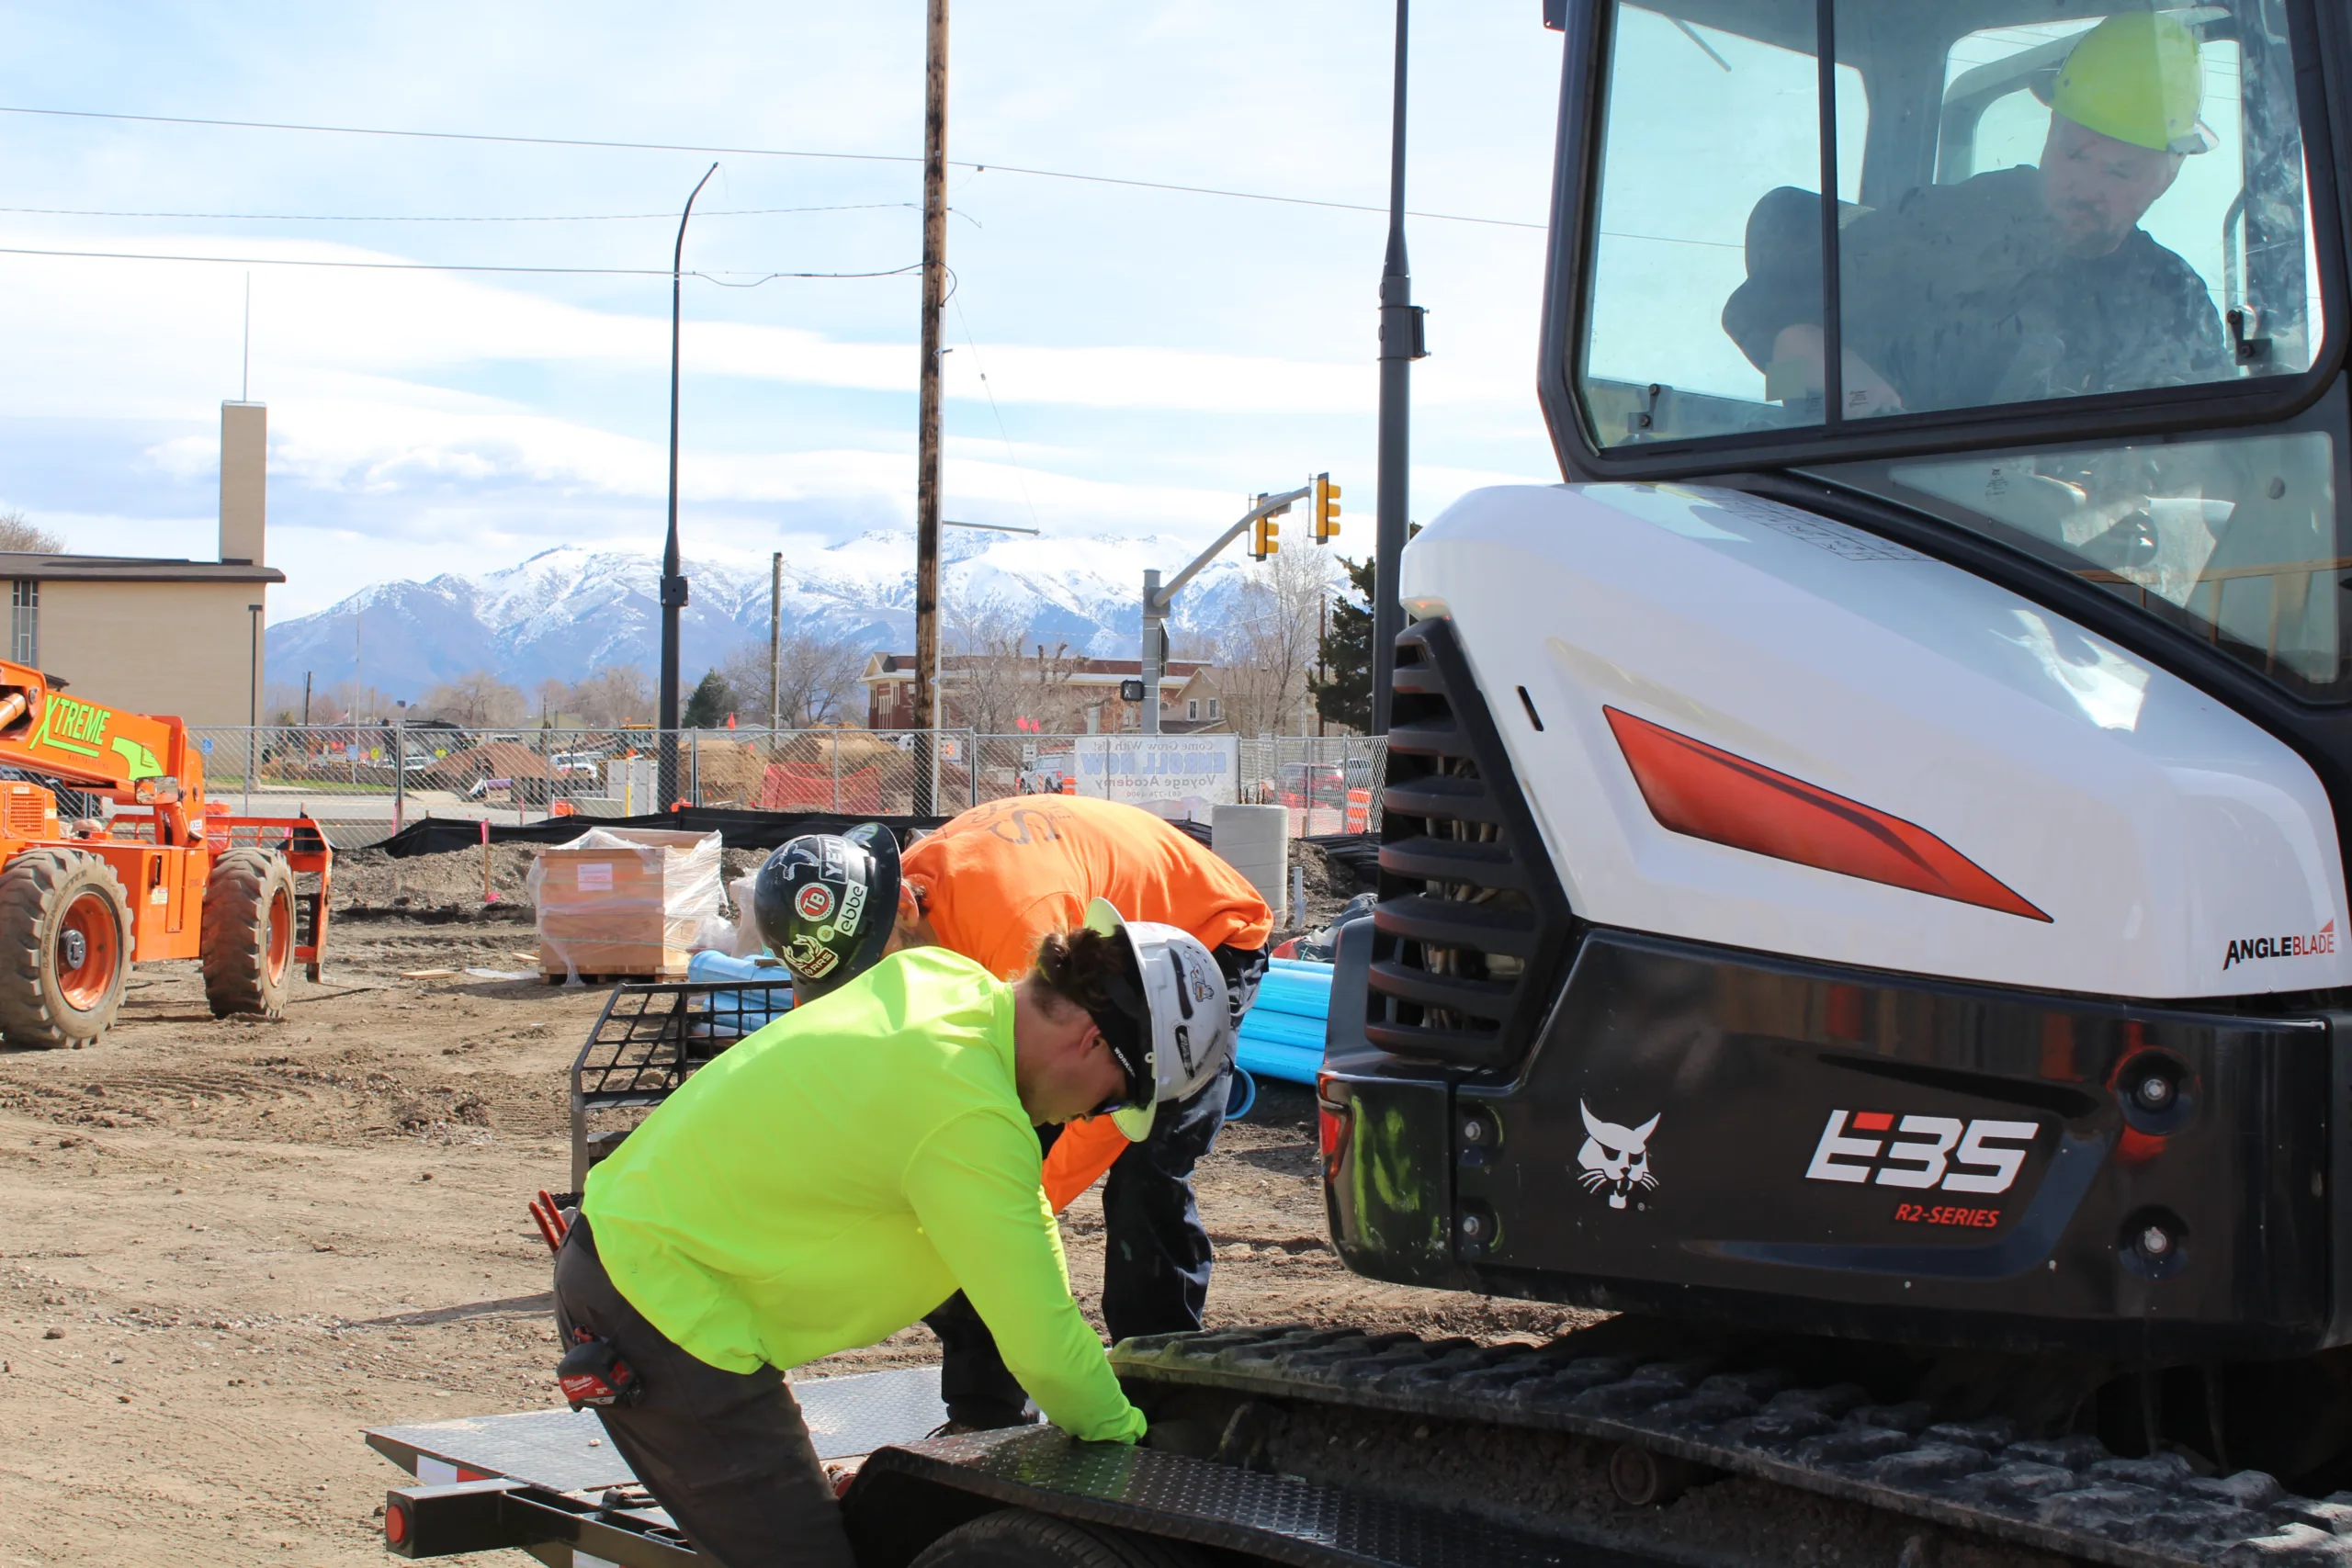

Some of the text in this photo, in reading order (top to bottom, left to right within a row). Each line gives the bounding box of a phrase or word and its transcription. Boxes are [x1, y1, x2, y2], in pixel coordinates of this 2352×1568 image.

[28, 694, 111, 753] XTREME
[823, 839, 843, 877] YETI
[802, 892, 826, 911] TB
[841, 886, 864, 932] ebbe
[809, 952, 832, 972] RRS
[2222, 933, 2335, 971] ANGLEBLADE
[1805, 1110, 2040, 1193] E35
[1894, 1203, 2000, 1228] R2-SERIES
